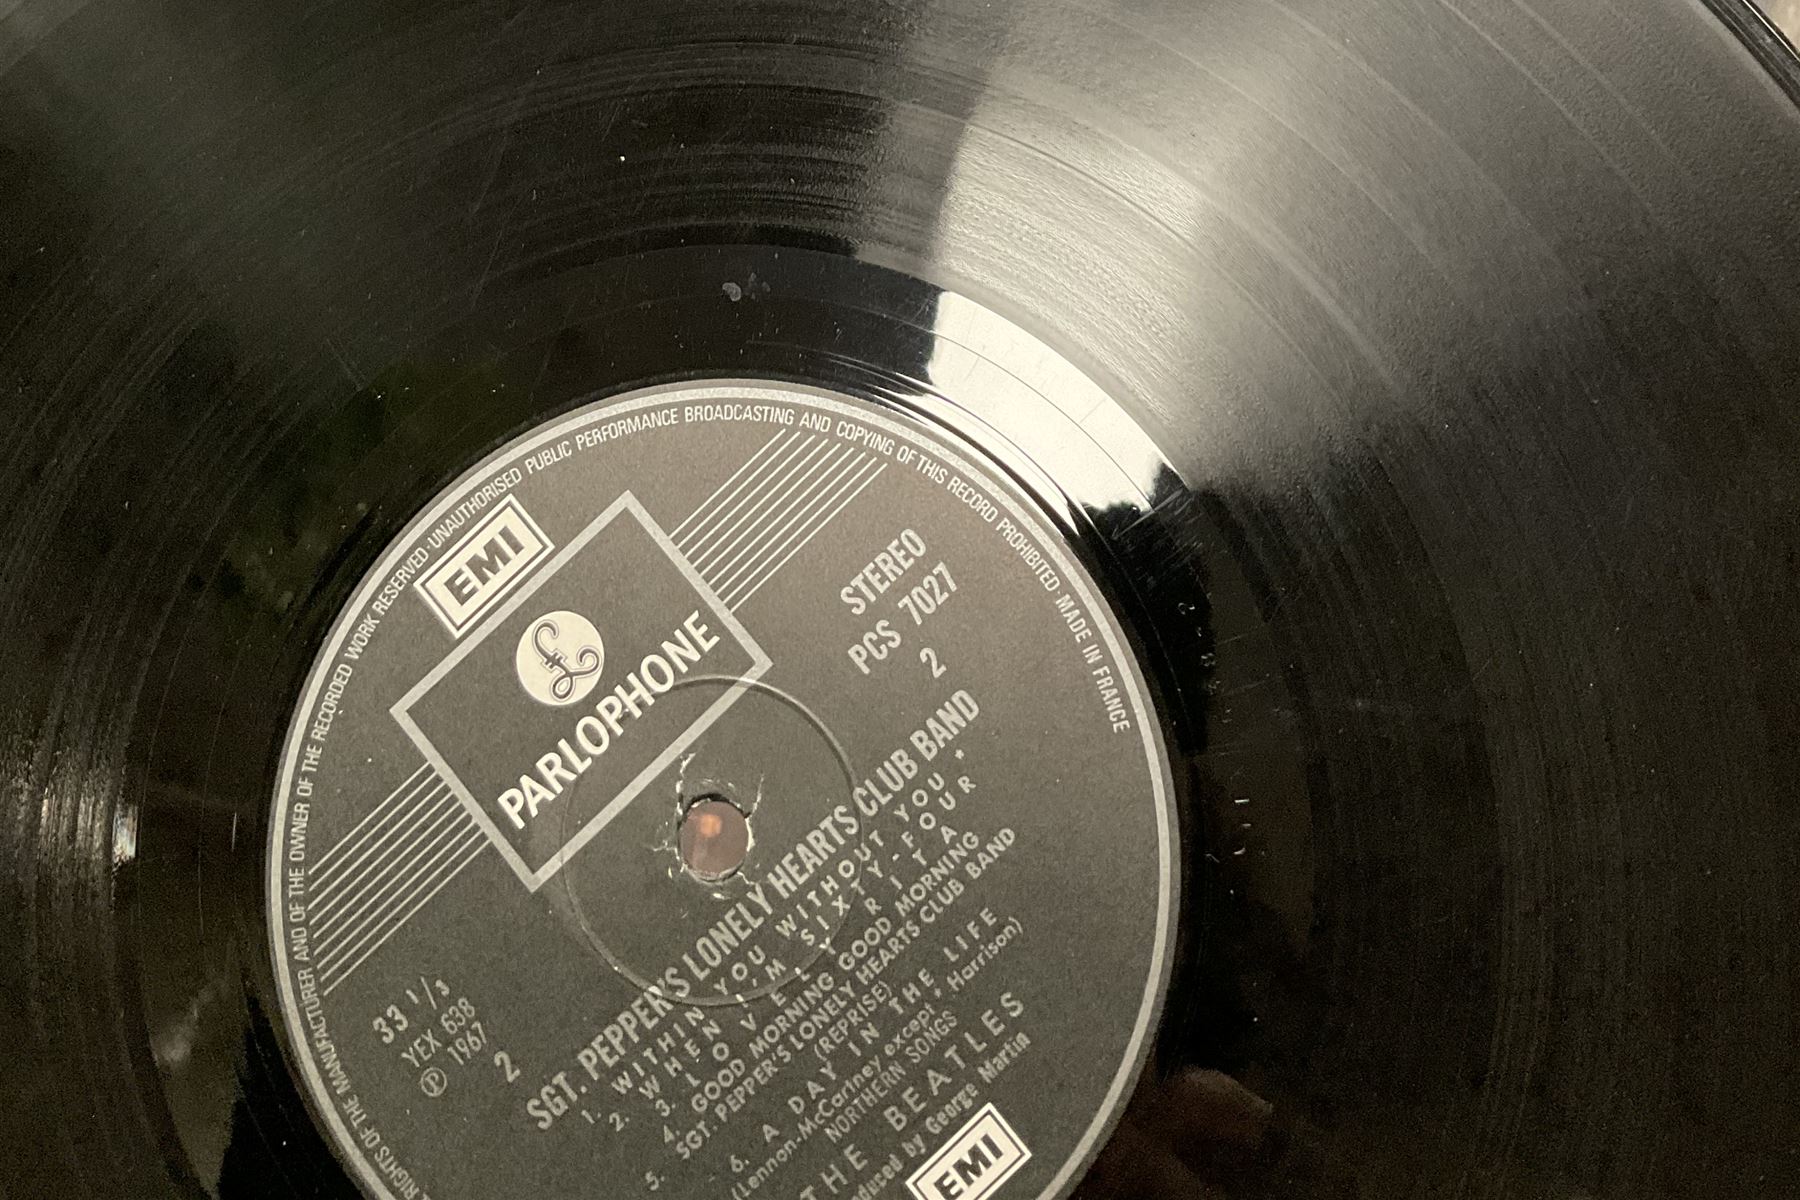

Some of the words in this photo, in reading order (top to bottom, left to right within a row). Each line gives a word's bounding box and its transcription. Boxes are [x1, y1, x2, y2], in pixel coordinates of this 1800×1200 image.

[576, 408, 678, 450] PERFORMANCE
[685, 404, 794, 425] BROADCASTING
[799, 412, 831, 432] AND
[837, 421, 895, 455] COPYING
[525, 441, 572, 474] PUBLIC
[897, 446, 917, 464] OF
[917, 455, 948, 483] THIS
[947, 476, 998, 522] RECORD
[444, 526, 524, 606] EMI
[841, 529, 926, 614] STEREO
[344, 614, 380, 659] WORK
[848, 620, 901, 674] PCS
[898, 562, 957, 625] 7027
[920, 648, 946, 678] 2
[1083, 644, 1102, 663] IN
[311, 664, 352, 741] RECORDED
[498, 610, 720, 829] PARLOPHONE
[1093, 666, 1130, 733] FRANCE
[302, 745, 322, 771] THE
[297, 778, 313, 796] OF
[289, 803, 310, 861] OWNER
[289, 868, 304, 898] THE
[527, 1072, 587, 1129] SGT.
[682, 882, 773, 980] LONELY
[767, 806, 858, 898] HEARTS
[853, 749, 917, 816] CLUB
[910, 690, 979, 761] BAND
[289, 903, 305, 922] OF
[611, 1007, 704, 1094] WITHIN
[714, 945, 765, 995] YOU
[776, 830, 883, 936] WITHOUT
[894, 773, 944, 822] YOU
[291, 927, 310, 960] AND
[685, 935, 836, 1087] LOVELY
[864, 826, 957, 914] RITA
[676, 1121, 717, 1159] SGT.
[715, 1045, 791, 1122] PEPPER'S
[790, 980, 855, 1050] LONELY
[856, 920, 920, 985] HEARTS
[920, 879, 964, 922] CLUB
[966, 829, 1014, 879] BAND
[692, 1059, 745, 1112] GOOD
[749, 973, 834, 1059] MORNING
[839, 918, 891, 970] GOOD
[895, 832, 978, 917] MORNING
[884, 1003, 935, 1056] except
[947, 917, 1023, 991] Harrison)
[298, 968, 350, 1094] MANUFACTURER
[373, 1005, 408, 1043] 33
[401, 1029, 442, 1067] YEX
[441, 998, 475, 1034] 638
[447, 1022, 486, 1065] 1967
[763, 1125, 779, 1142] A
[788, 1061, 836, 1114] DAY
[848, 1022, 879, 1056] IN
[889, 968, 934, 1014] THE
[944, 908, 996, 961] LIFE
[814, 981, 892, 1061] (REPRISE)
[494, 1051, 520, 1082] 2
[639, 1019, 721, 1099] WHEN
[824, 1061, 906, 1143] NORTHERN
[905, 1011, 957, 1063] SONGS
[884, 992, 1023, 1131] BEATLES
[343, 1095, 366, 1128] THE
[902, 1134, 926, 1157] by
[926, 1084, 978, 1134] George
[978, 1032, 1030, 1083] Martin
[360, 1128, 380, 1148] OF
[375, 1146, 419, 1200] RIGHTS
[933, 1133, 1004, 1200] EMI
